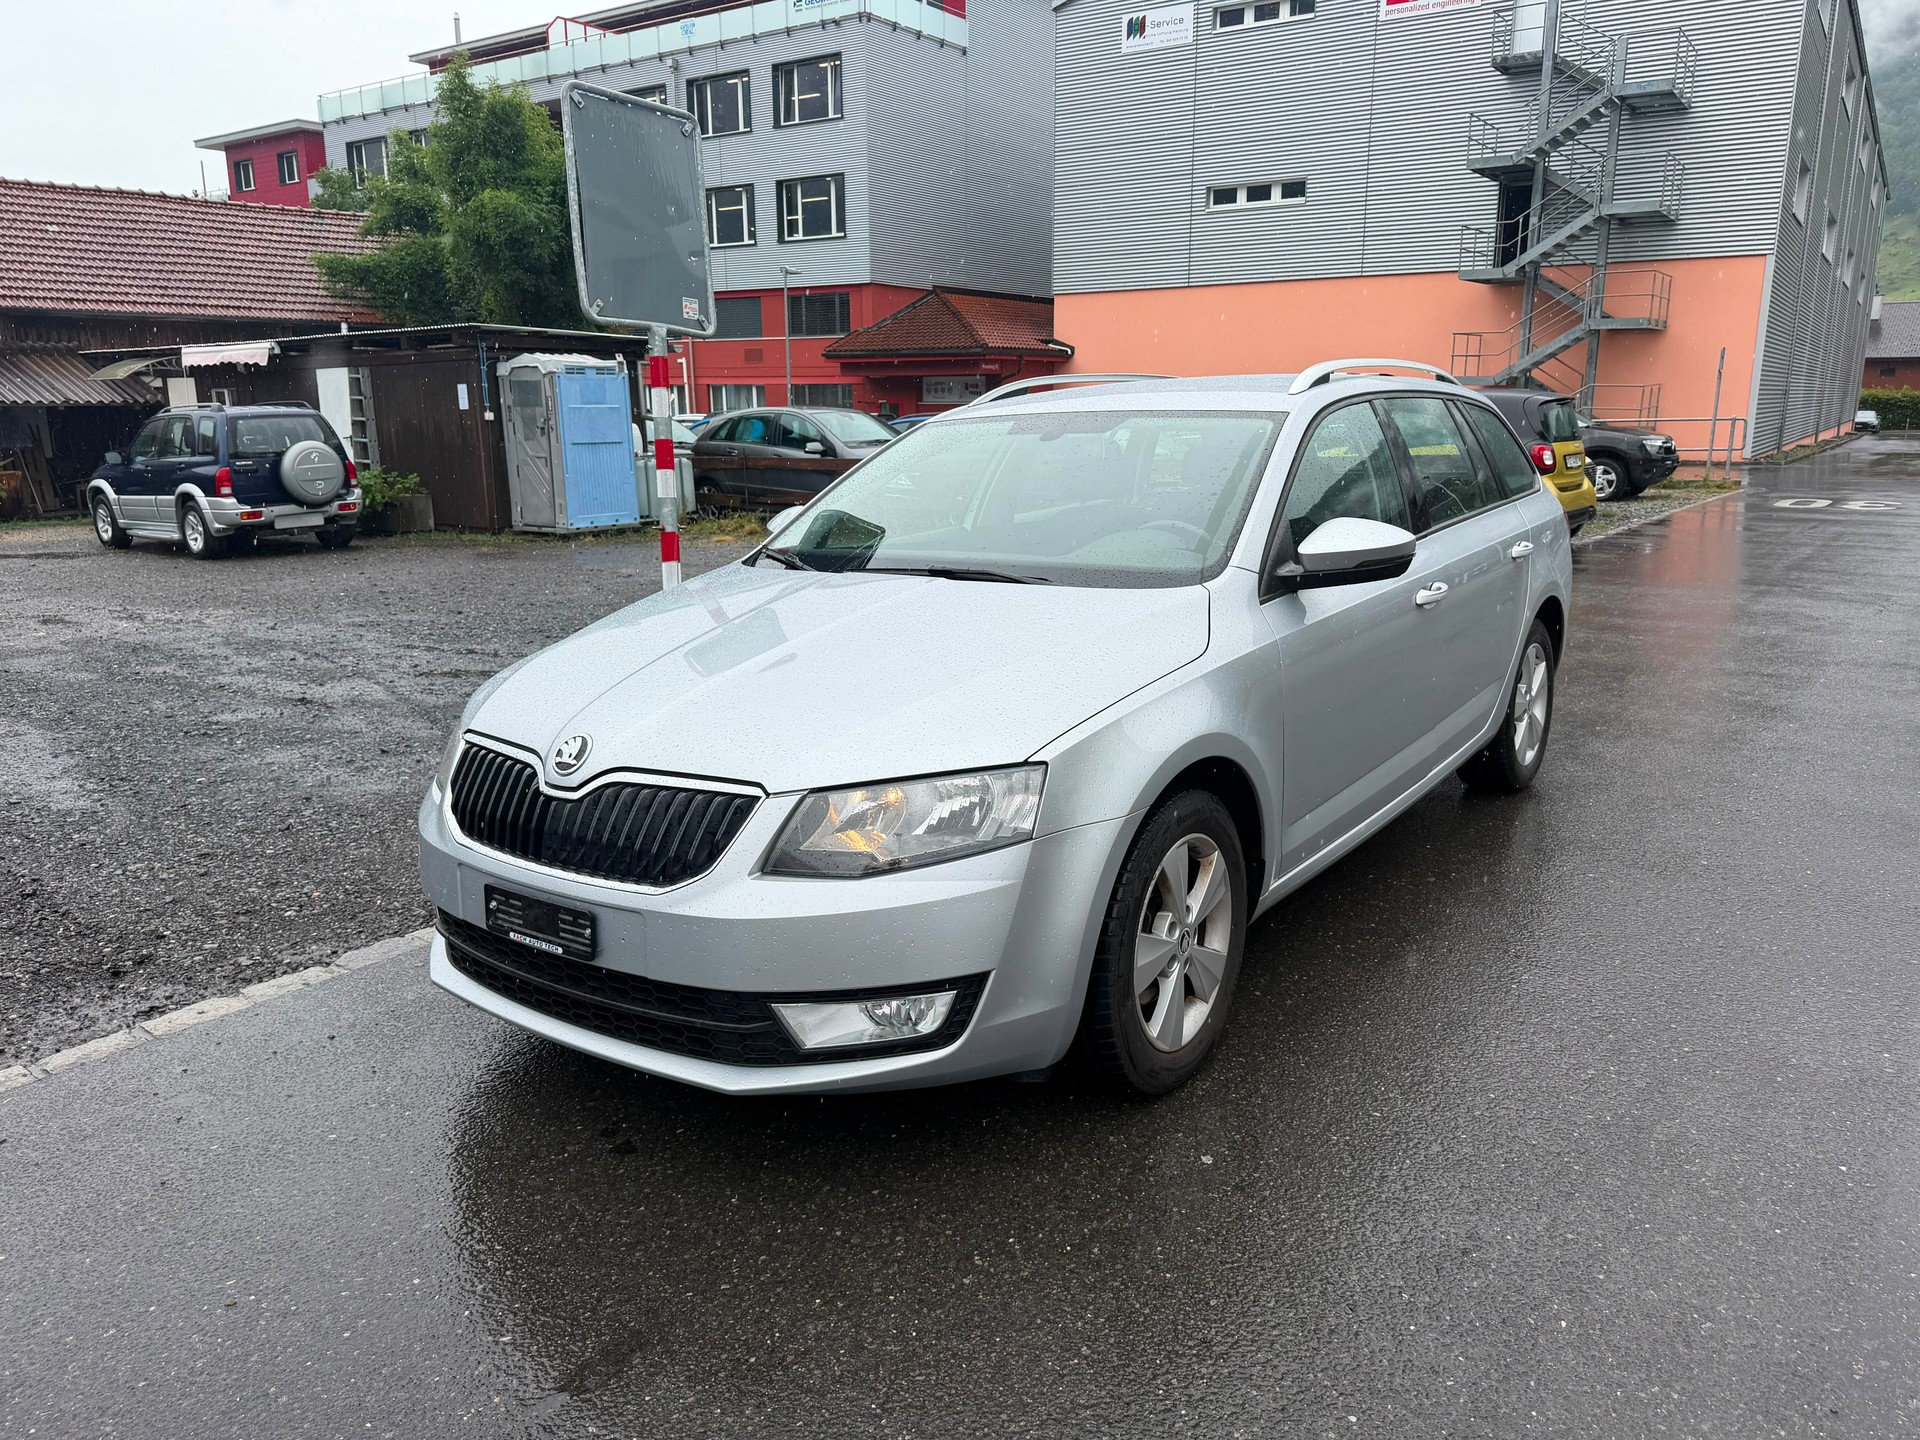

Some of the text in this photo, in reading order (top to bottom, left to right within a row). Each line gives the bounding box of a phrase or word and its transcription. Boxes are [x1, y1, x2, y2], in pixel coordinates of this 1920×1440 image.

[1385, 0, 1475, 18] personalized engineering
[529, 938, 544, 947] AUTO
[544, 943, 559, 952] TECH
